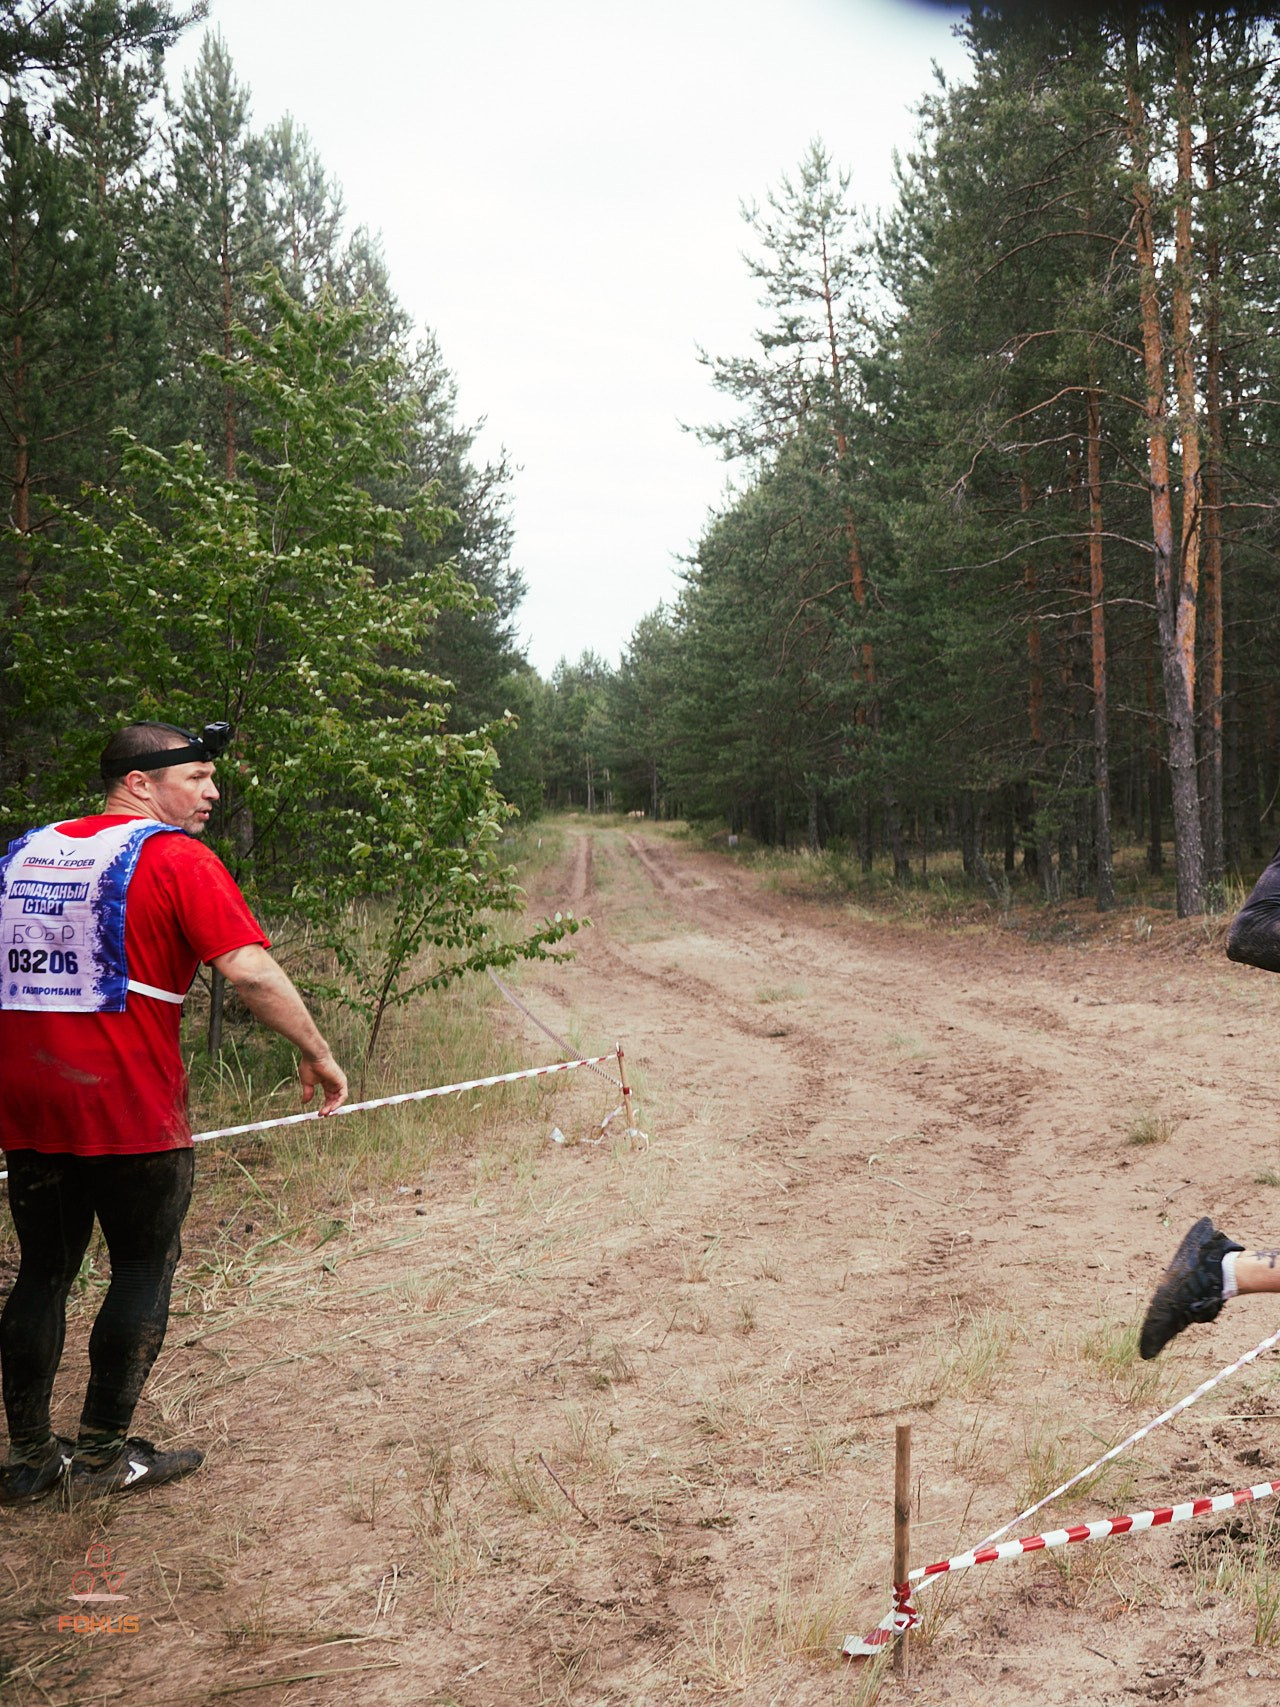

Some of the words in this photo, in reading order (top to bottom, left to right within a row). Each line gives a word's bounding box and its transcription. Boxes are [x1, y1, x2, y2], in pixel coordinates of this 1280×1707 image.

[23, 856, 55, 866] ГОНКА
[57, 858, 95, 867] ГЕРОЕВ
[10, 882, 88, 900] КОМАНДНЫЙ
[25, 900, 62, 914] СТАРТ
[13, 924, 75, 945] БОБР
[8, 949, 79, 974] 03206
[22, 986, 82, 996] ГАЗПРОМБАНК
